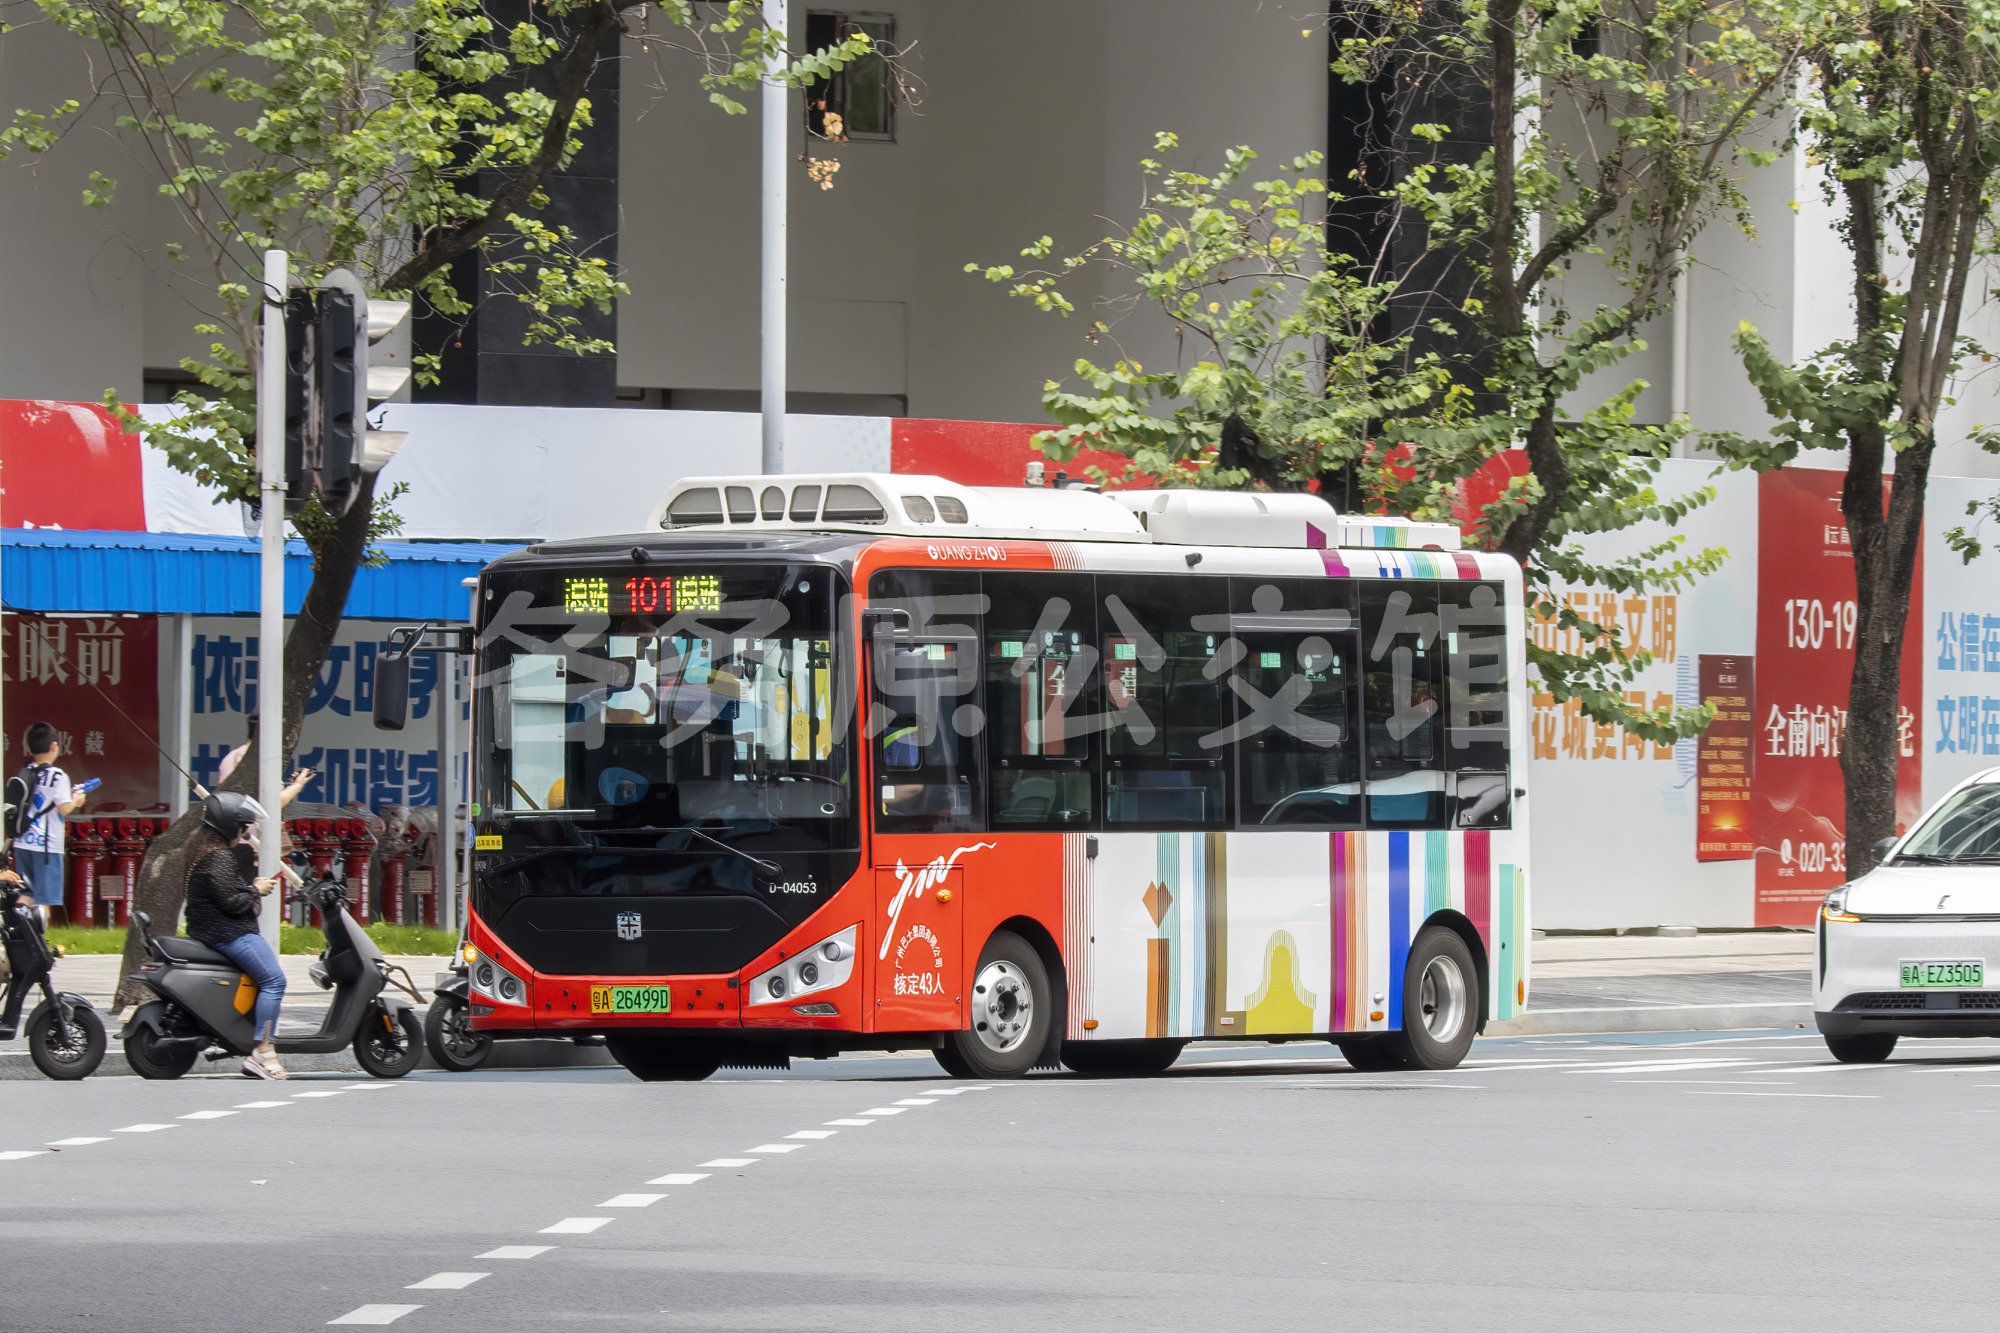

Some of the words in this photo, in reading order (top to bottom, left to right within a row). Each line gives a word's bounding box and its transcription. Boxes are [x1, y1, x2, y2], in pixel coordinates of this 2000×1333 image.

[625, 576, 672, 612] 101
[1785, 599, 1858, 649] 130-19
[1935, 695, 2000, 754] 文明在
[1800, 842, 1846, 872] 020-33
[769, 882, 817, 894] D-04053
[894, 972, 945, 995] 核定43人
